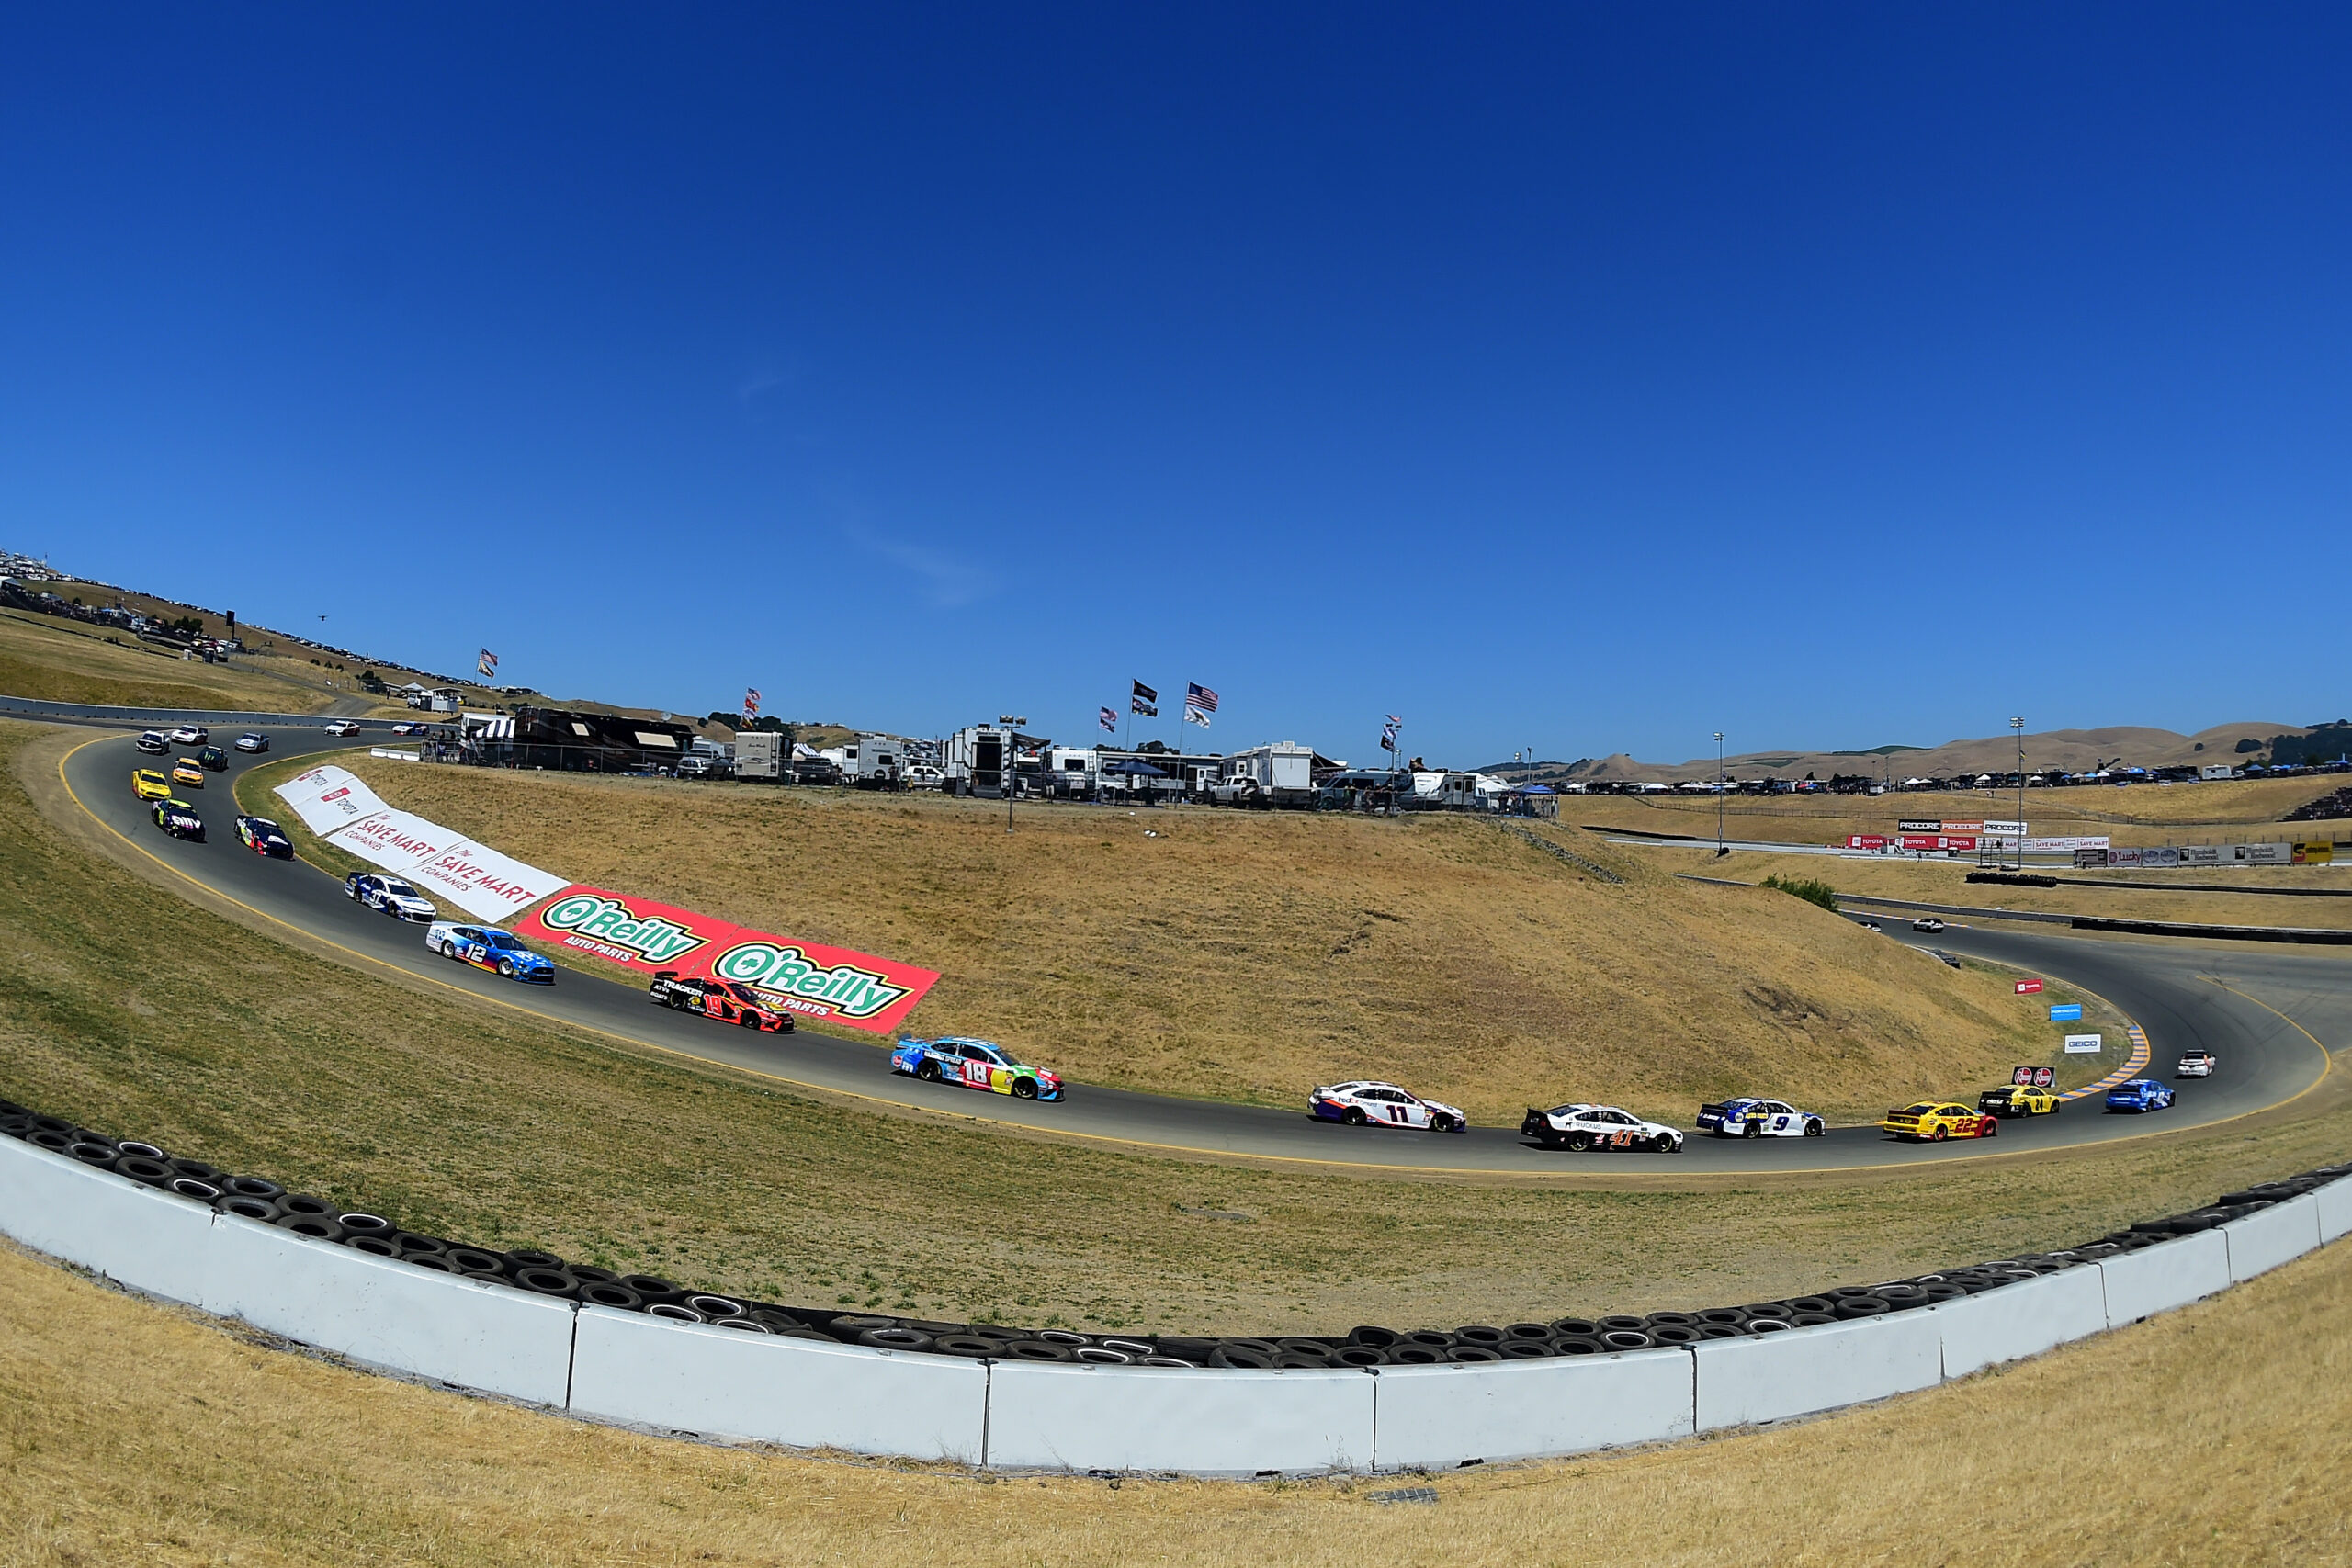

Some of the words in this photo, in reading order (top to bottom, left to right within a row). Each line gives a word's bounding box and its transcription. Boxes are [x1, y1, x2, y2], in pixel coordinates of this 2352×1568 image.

[335, 797, 359, 816] TOYOTA
[1899, 821, 1939, 830] PROCORE
[1942, 822, 1982, 830] PROCORE
[1984, 823, 2025, 832] PROCORE
[345, 830, 385, 852] COMPANIES
[357, 820, 398, 840] SAVE
[387, 832, 436, 858] MART
[2118, 851, 2142, 863] Lucky
[421, 866, 474, 892] COMPANIES
[435, 856, 480, 880] SAVE
[474, 874, 537, 905] MART
[550, 898, 690, 958] O'Reilly
[465, 943, 488, 964] 12
[562, 935, 598, 950] AUTO
[596, 943, 634, 963] PARTS
[663, 979, 704, 998] TRACKER
[724, 947, 893, 1011] O'Reilly
[704, 993, 723, 1017] 19
[784, 998, 831, 1016] PARTS
[2068, 1040, 2098, 1048] GEICO
[963, 1060, 988, 1084] 18
[1385, 1104, 1410, 1124] 11
[1772, 1116, 1790, 1131] 9
[1954, 1118, 1974, 1134] 22
[1609, 1129, 1635, 1147] 41
